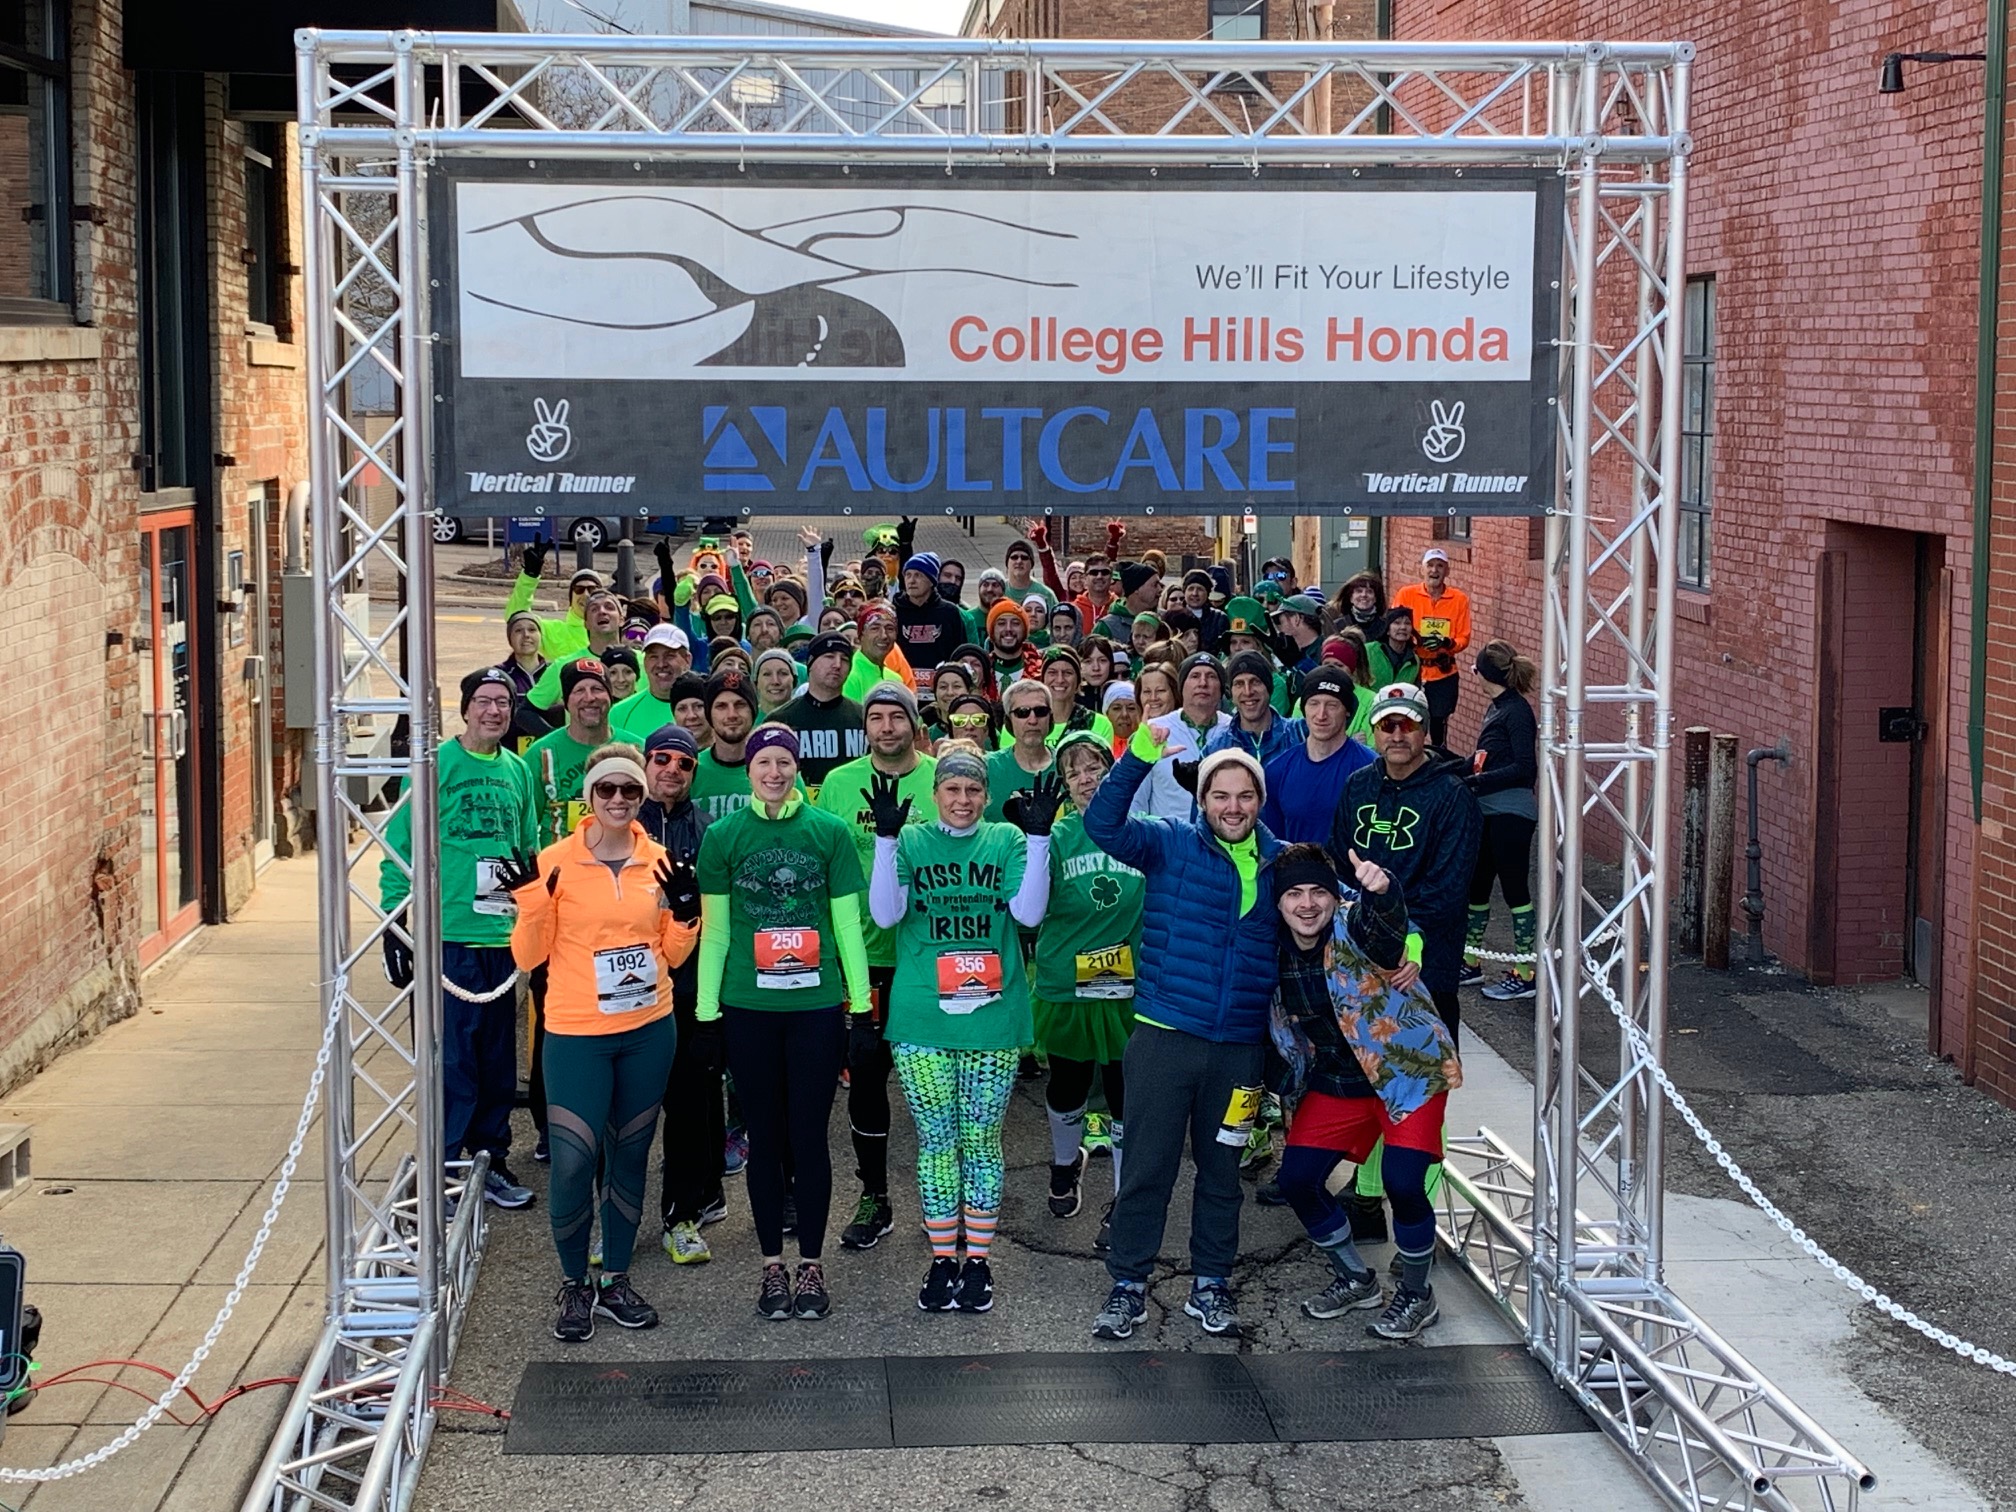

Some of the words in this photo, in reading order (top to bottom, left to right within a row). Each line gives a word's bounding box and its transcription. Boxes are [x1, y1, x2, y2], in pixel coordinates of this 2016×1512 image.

[1195, 264, 1264, 290] We'll
[1275, 264, 1309, 290] Fit
[1319, 264, 1383, 290] Your
[1393, 264, 1510, 296] Lifestyle
[949, 316, 1163, 374] College
[1184, 317, 1304, 362] Hills
[1327, 318, 1509, 362] Honda
[797, 406, 1296, 494] AULTCARE
[466, 472, 555, 493] Vertical
[558, 473, 636, 493] Runner
[1362, 473, 1449, 493] Vertical
[1450, 473, 1528, 493] Runner
[914, 671, 931, 681] 355
[795, 729, 839, 759] ARD
[1061, 851, 1106, 881] LUCKY
[913, 862, 962, 895] KISS
[968, 861, 1002, 891] ME
[943, 892, 994, 906] pretending
[929, 914, 992, 940] IRISH
[771, 932, 803, 950] 250
[607, 952, 647, 973] 1992
[954, 956, 986, 974] 356
[1087, 950, 1121, 969] 2101
